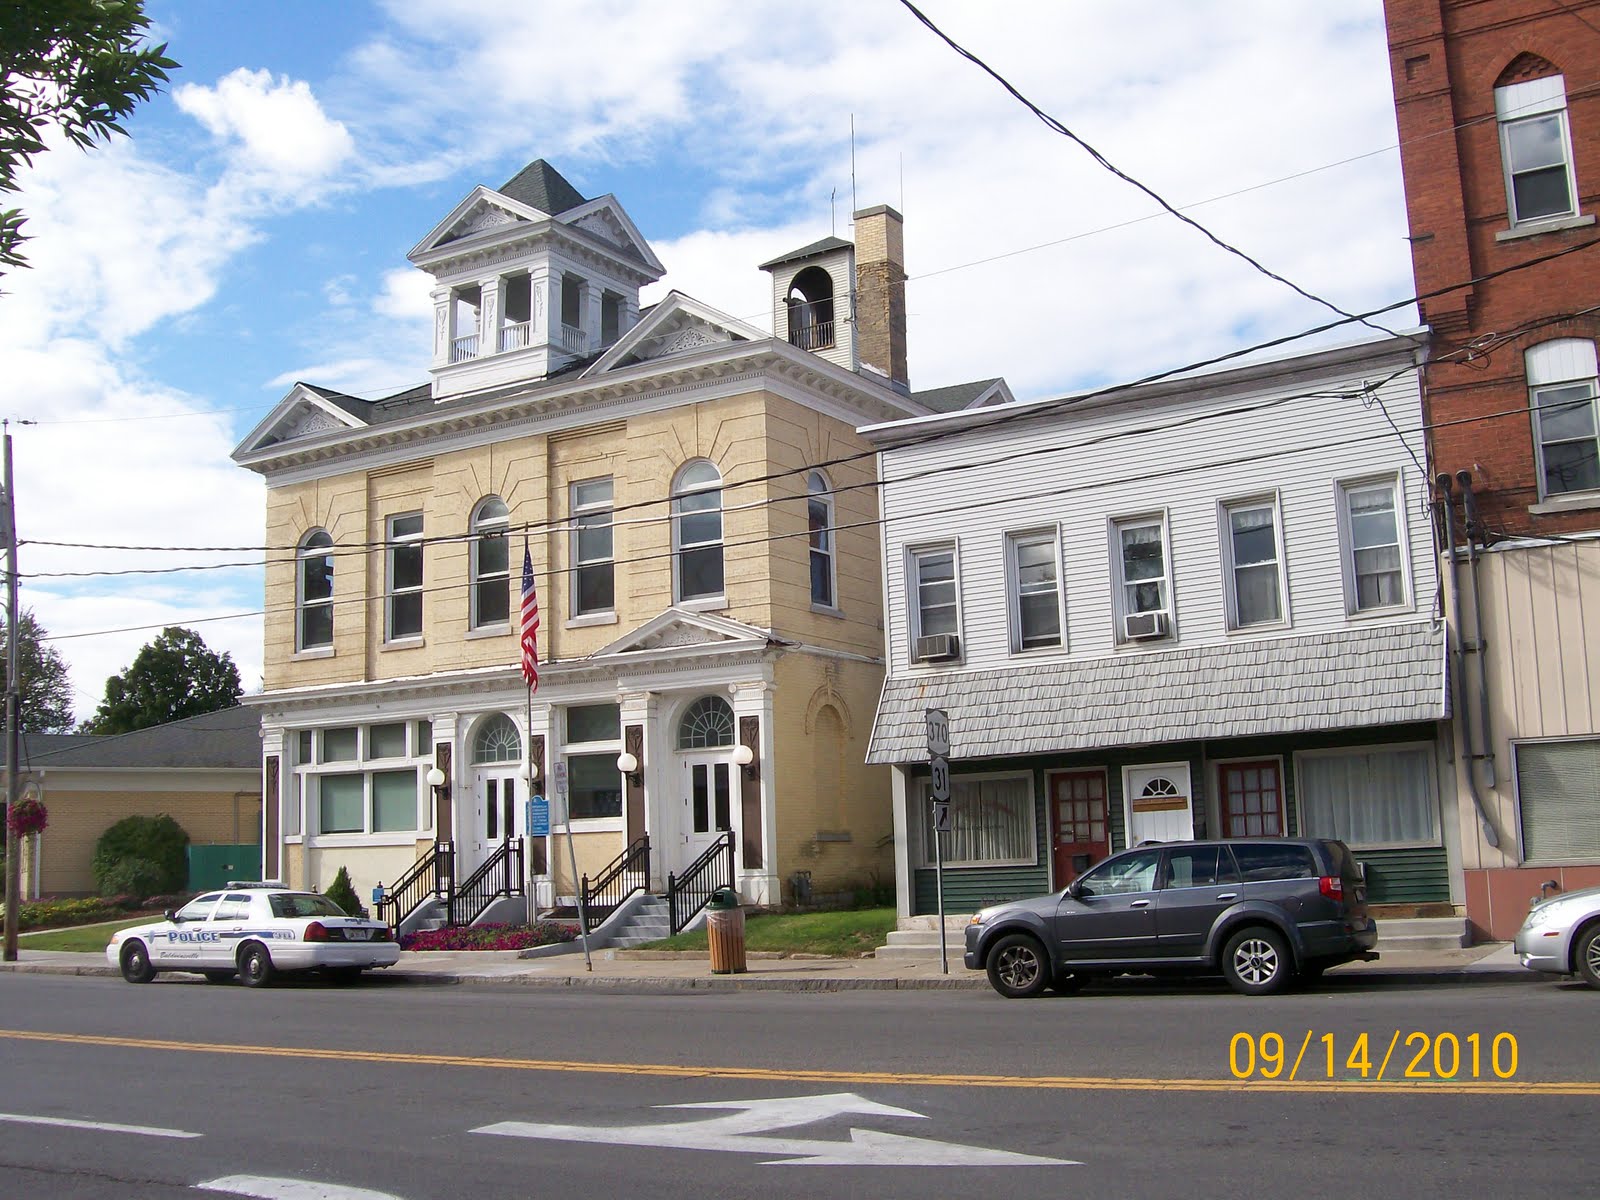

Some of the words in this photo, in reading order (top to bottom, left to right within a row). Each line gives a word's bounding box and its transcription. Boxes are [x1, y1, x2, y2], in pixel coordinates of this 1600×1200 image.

[928, 721, 948, 743] 370
[934, 767, 946, 791] 31
[167, 931, 220, 943] POLICE
